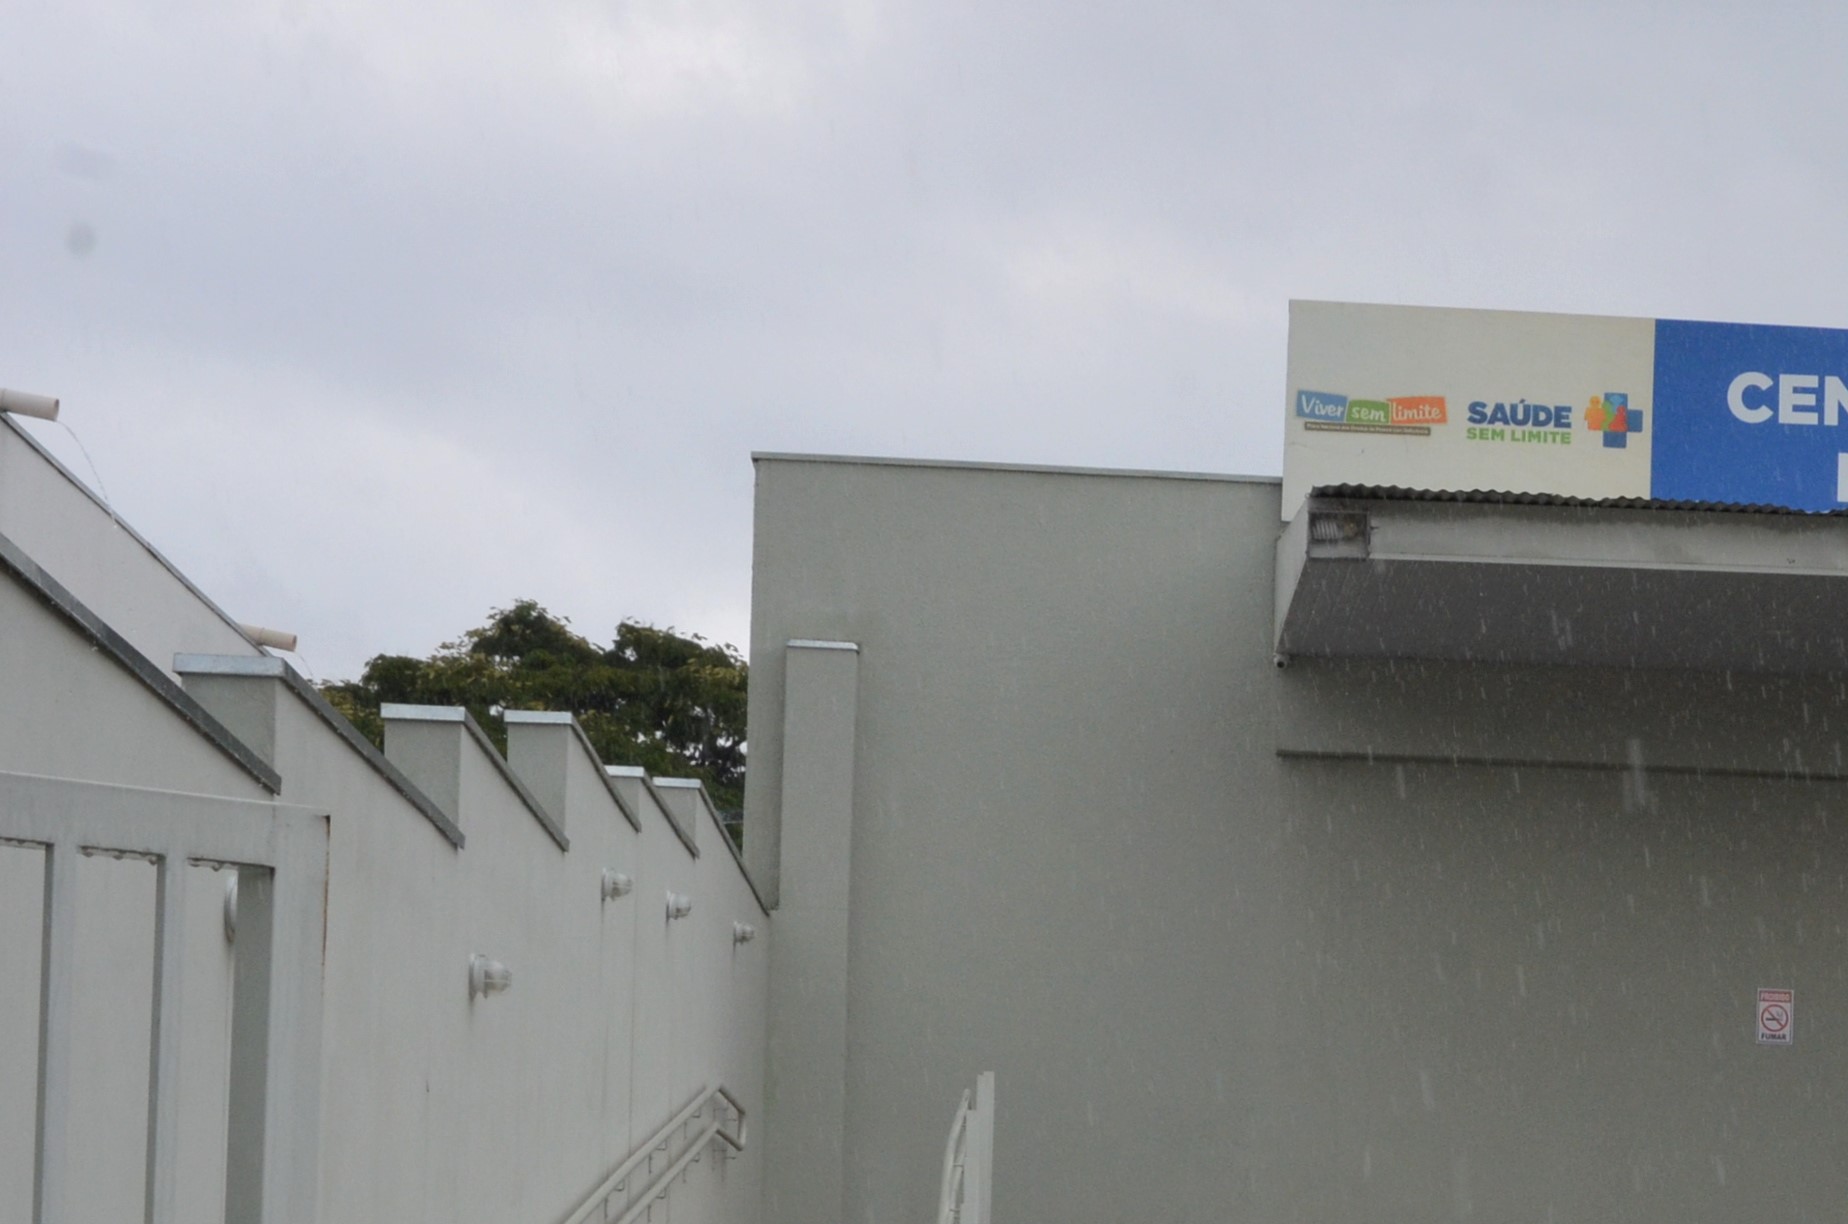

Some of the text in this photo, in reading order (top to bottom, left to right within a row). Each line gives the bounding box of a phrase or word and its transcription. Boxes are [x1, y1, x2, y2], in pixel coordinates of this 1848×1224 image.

[1301, 394, 1442, 422] Viver sem limite
[1467, 398, 1572, 429] SAÚDE
[1466, 427, 1572, 444] SEM LIMITE
[1761, 1032, 1787, 1040] FUMAR
